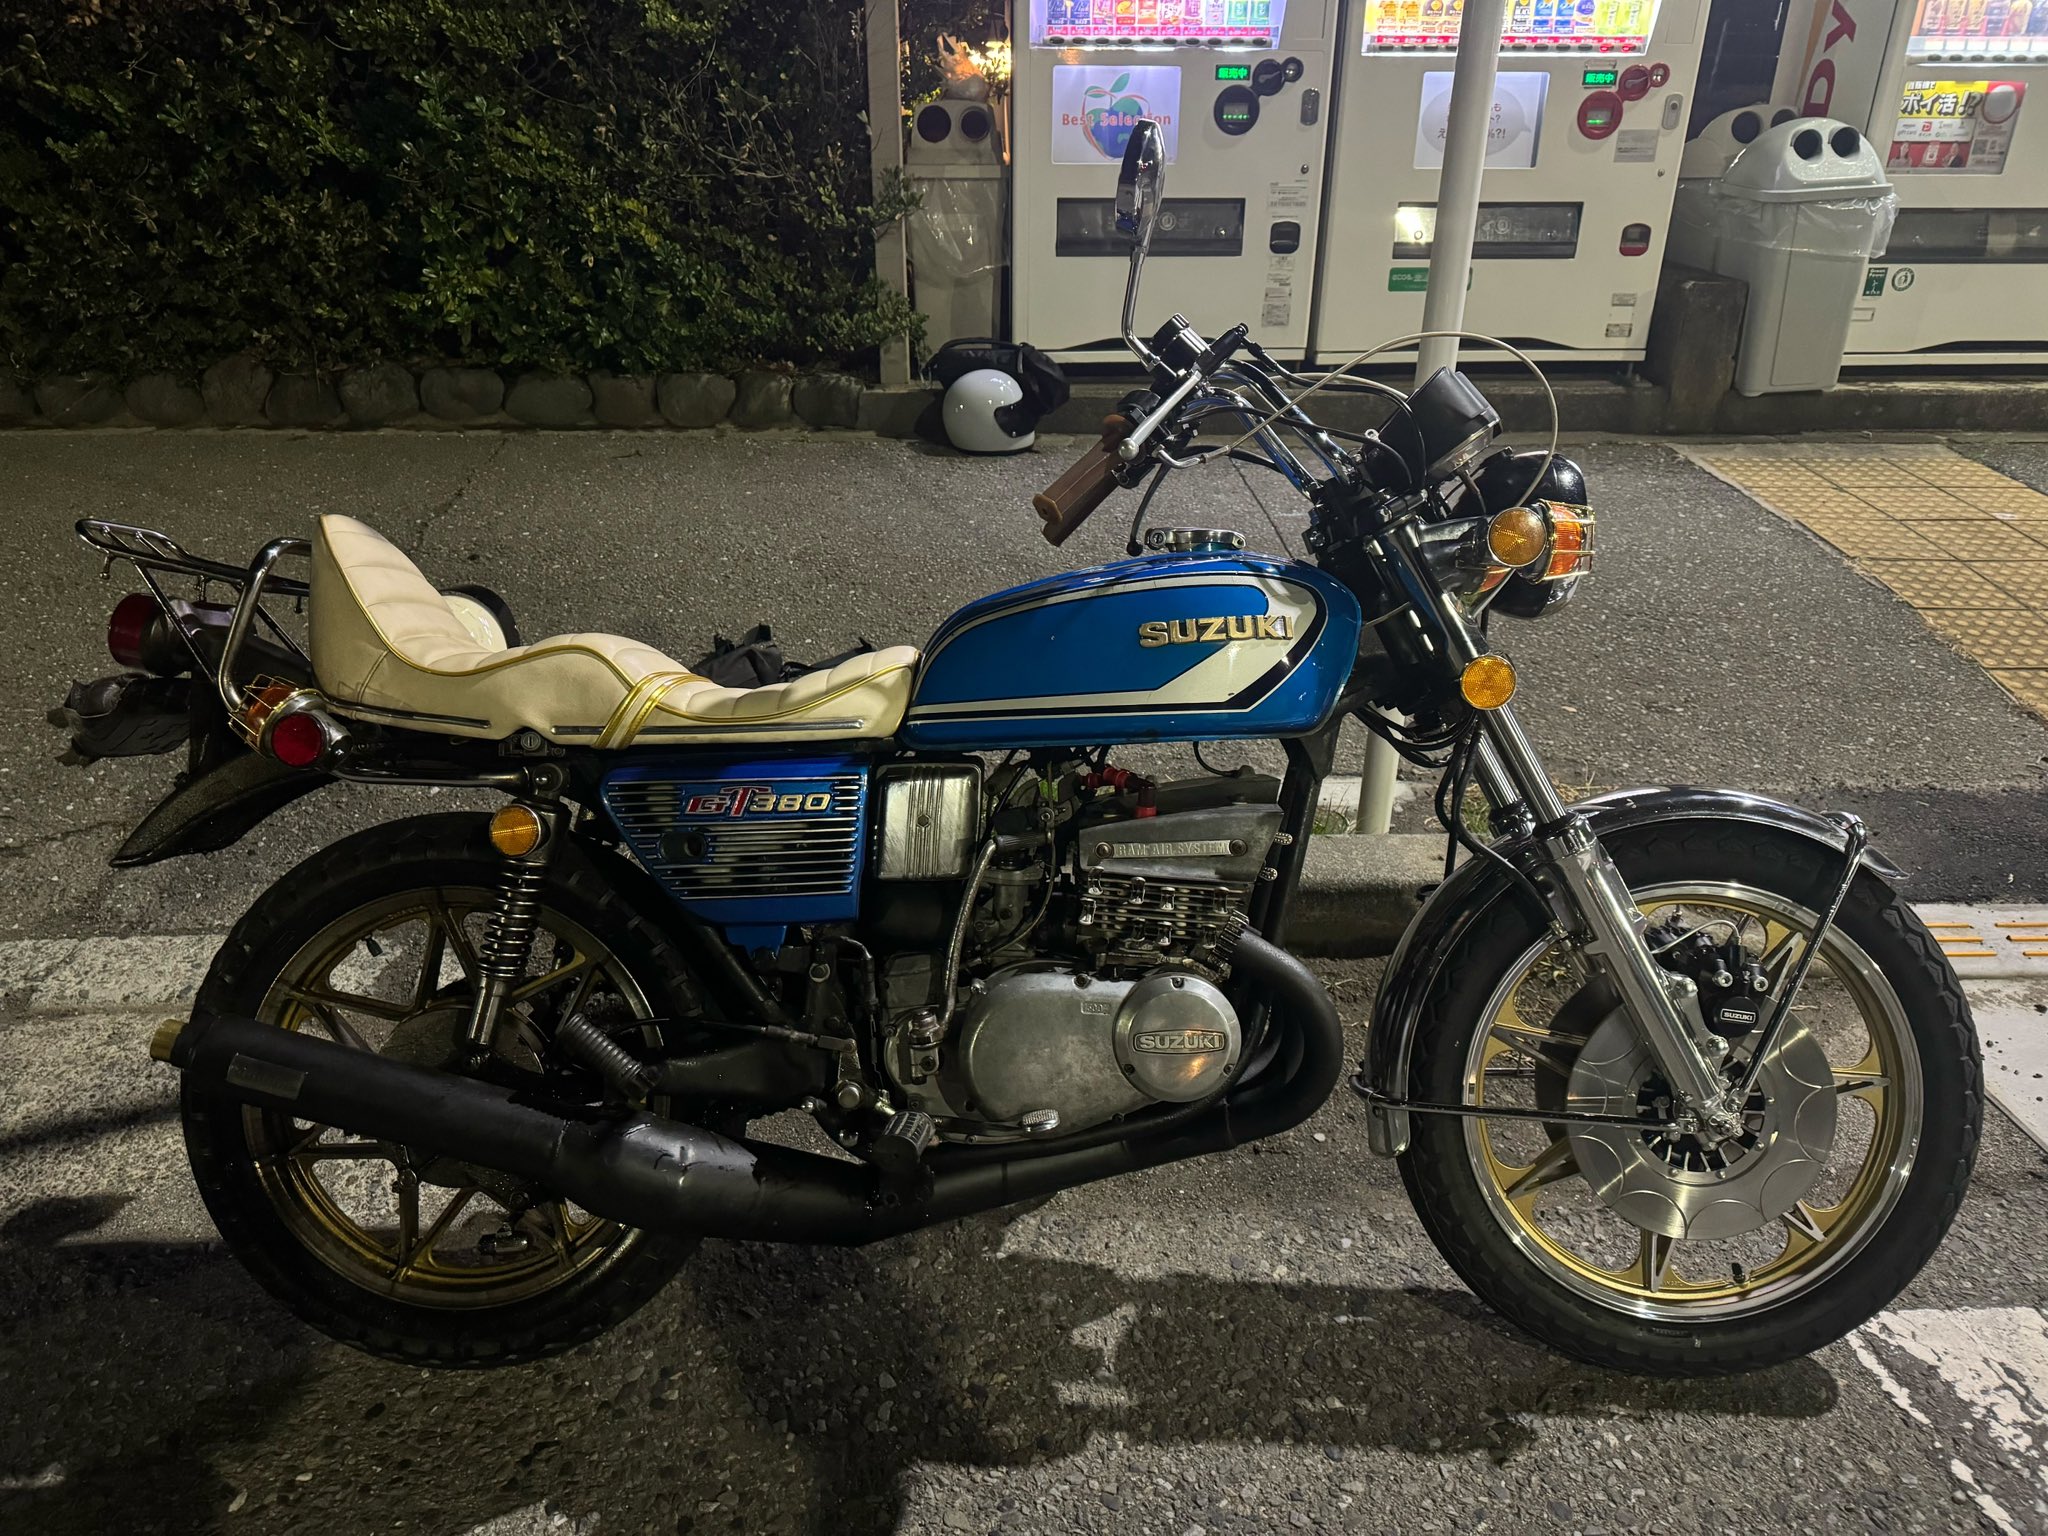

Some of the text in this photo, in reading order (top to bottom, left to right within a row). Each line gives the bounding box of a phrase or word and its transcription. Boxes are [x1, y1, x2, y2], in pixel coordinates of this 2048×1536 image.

[1218, 66, 1248, 79] 販売中
[1585, 73, 1615, 83] 販売中
[1062, 113, 1095, 126] Best
[1139, 615, 1294, 647] SUZUKI
[683, 785, 832, 818] GT380
[1118, 839, 1227, 856] RAM AIR SYSTEM
[1723, 1011, 1754, 1021] SUZUKI
[1138, 1034, 1222, 1050] SUZUKI
